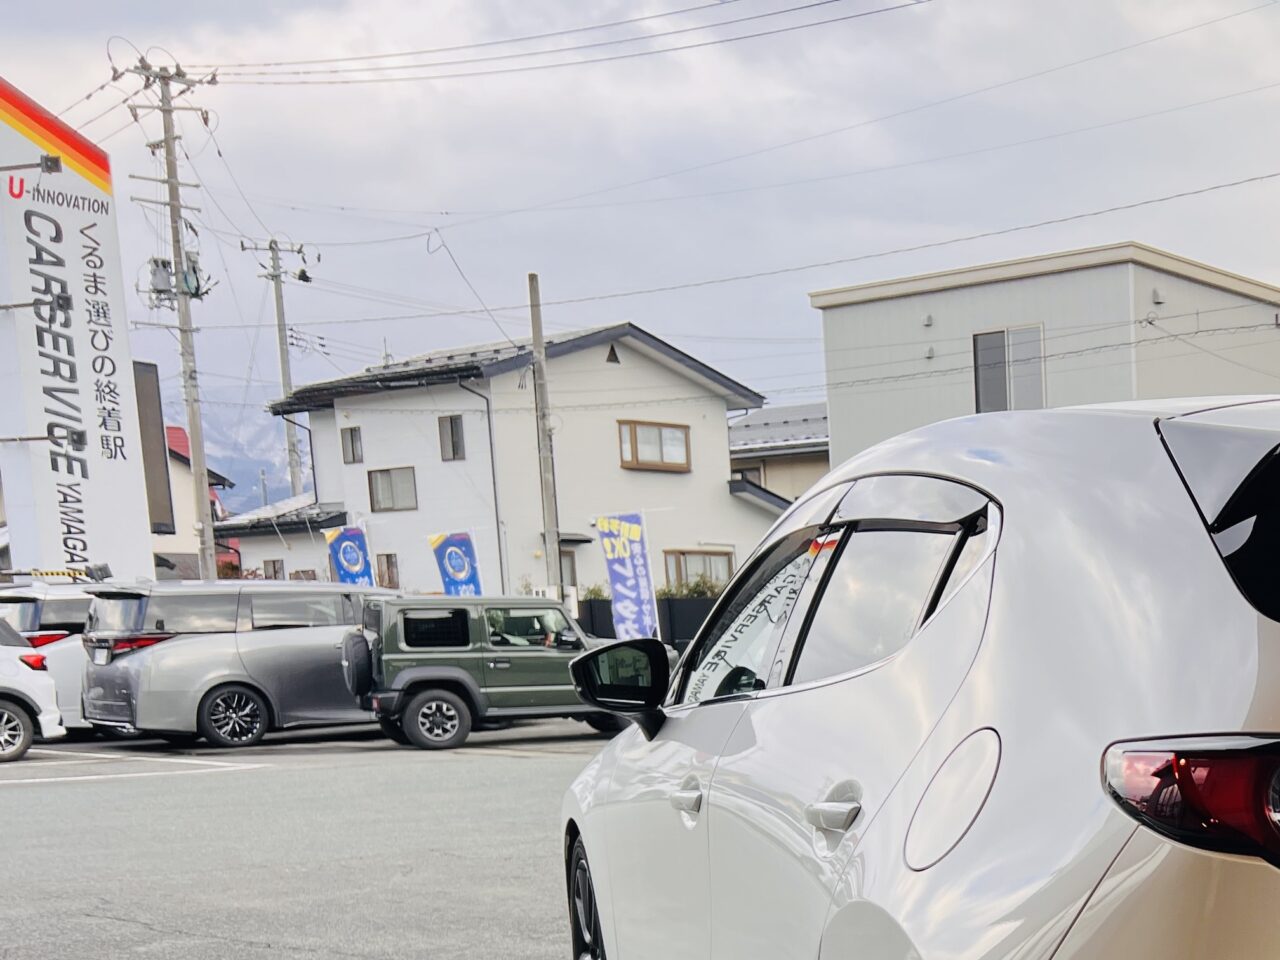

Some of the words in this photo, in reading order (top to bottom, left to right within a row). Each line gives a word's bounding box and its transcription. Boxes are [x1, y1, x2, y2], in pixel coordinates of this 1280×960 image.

[79, 223, 127, 460] くるま選びの終着駅
